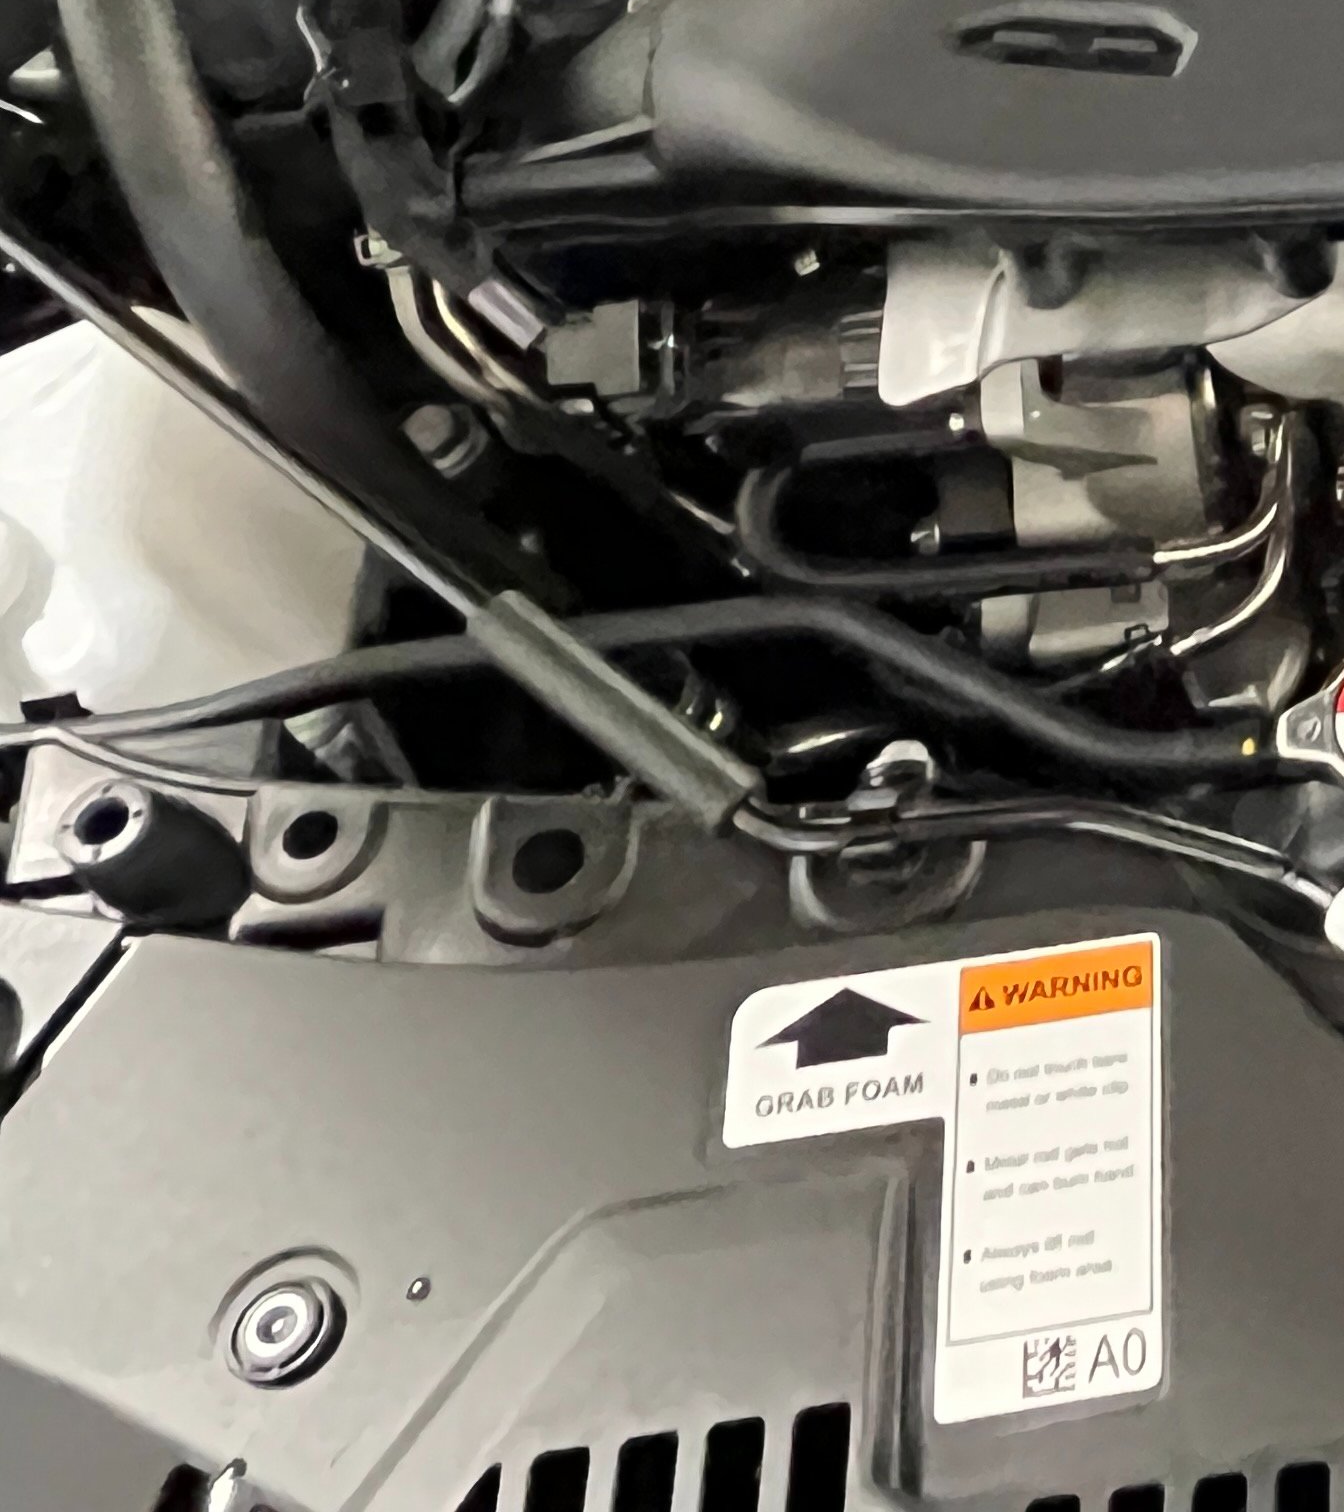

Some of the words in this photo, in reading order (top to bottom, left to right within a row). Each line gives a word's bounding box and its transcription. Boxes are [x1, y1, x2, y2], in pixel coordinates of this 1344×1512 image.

[1002, 965, 1143, 1006] WARNING
[755, 1086, 835, 1117] GRAB
[845, 1071, 924, 1106] FOAM
